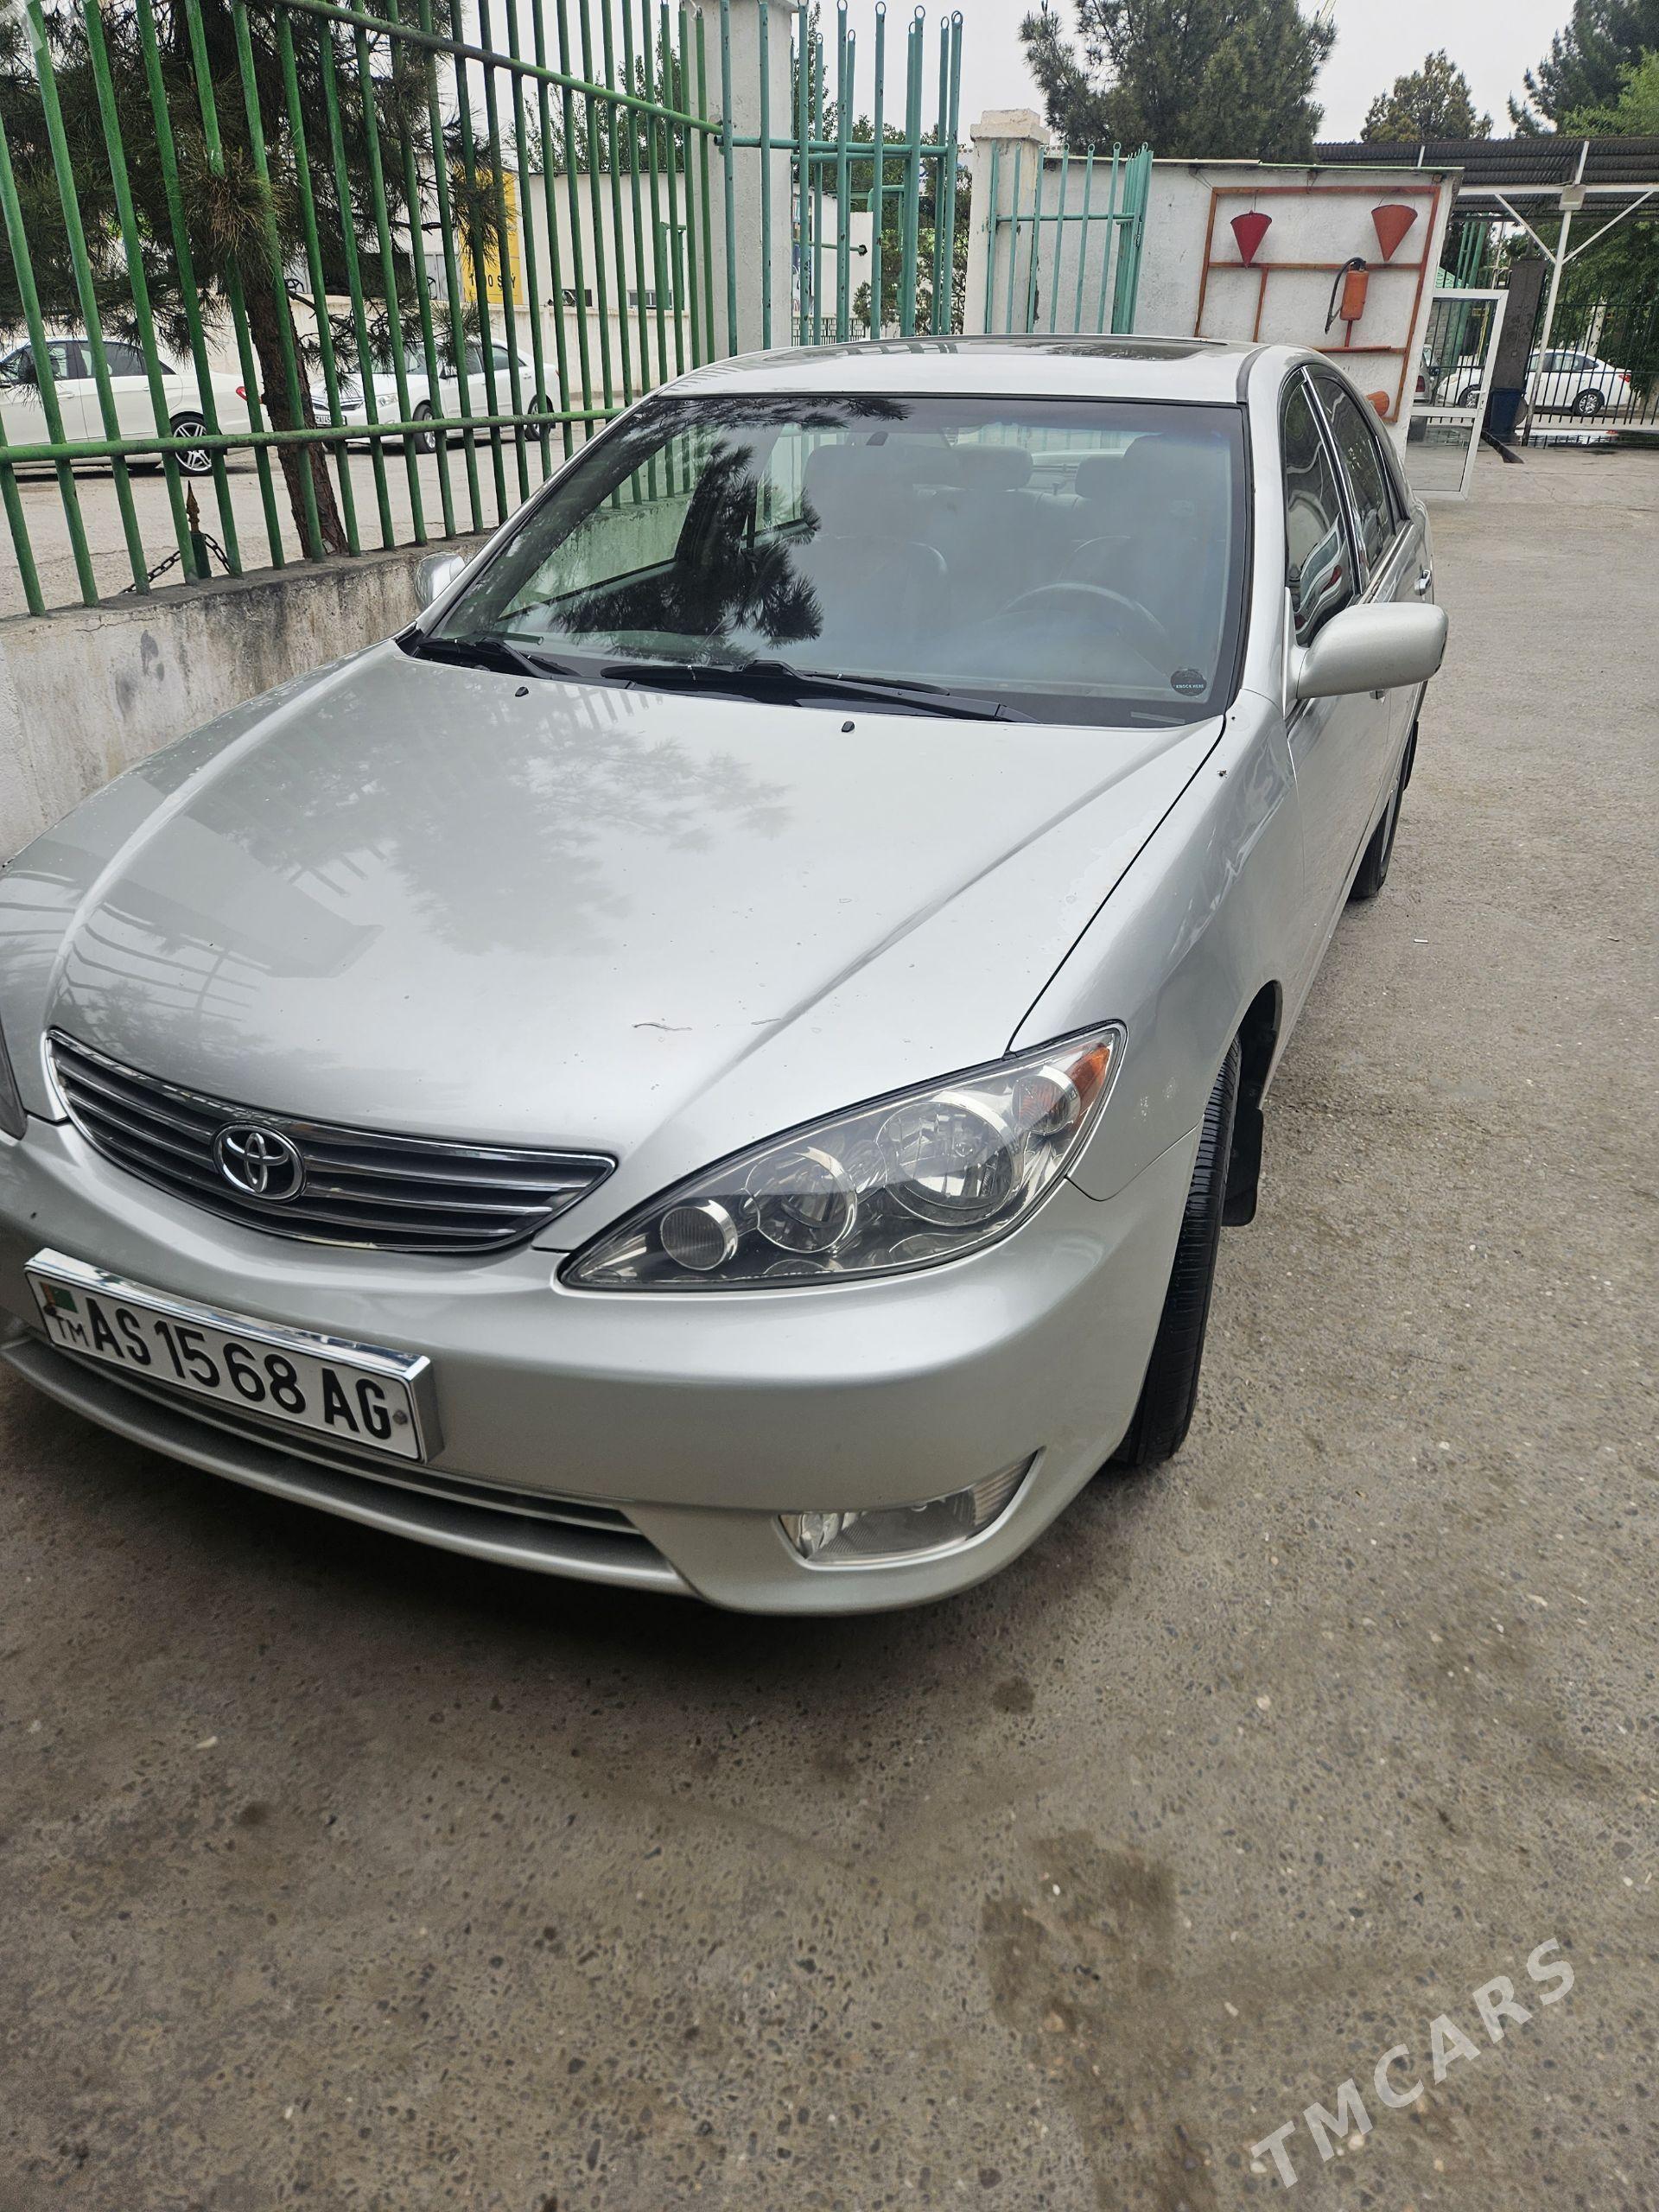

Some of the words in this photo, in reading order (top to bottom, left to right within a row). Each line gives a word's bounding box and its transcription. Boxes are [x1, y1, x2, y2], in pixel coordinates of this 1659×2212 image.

[54, 1315, 89, 1347] TM
[86, 1298, 150, 1365] AS
[154, 1319, 306, 1414] 1568
[321, 1367, 391, 1440] AG
